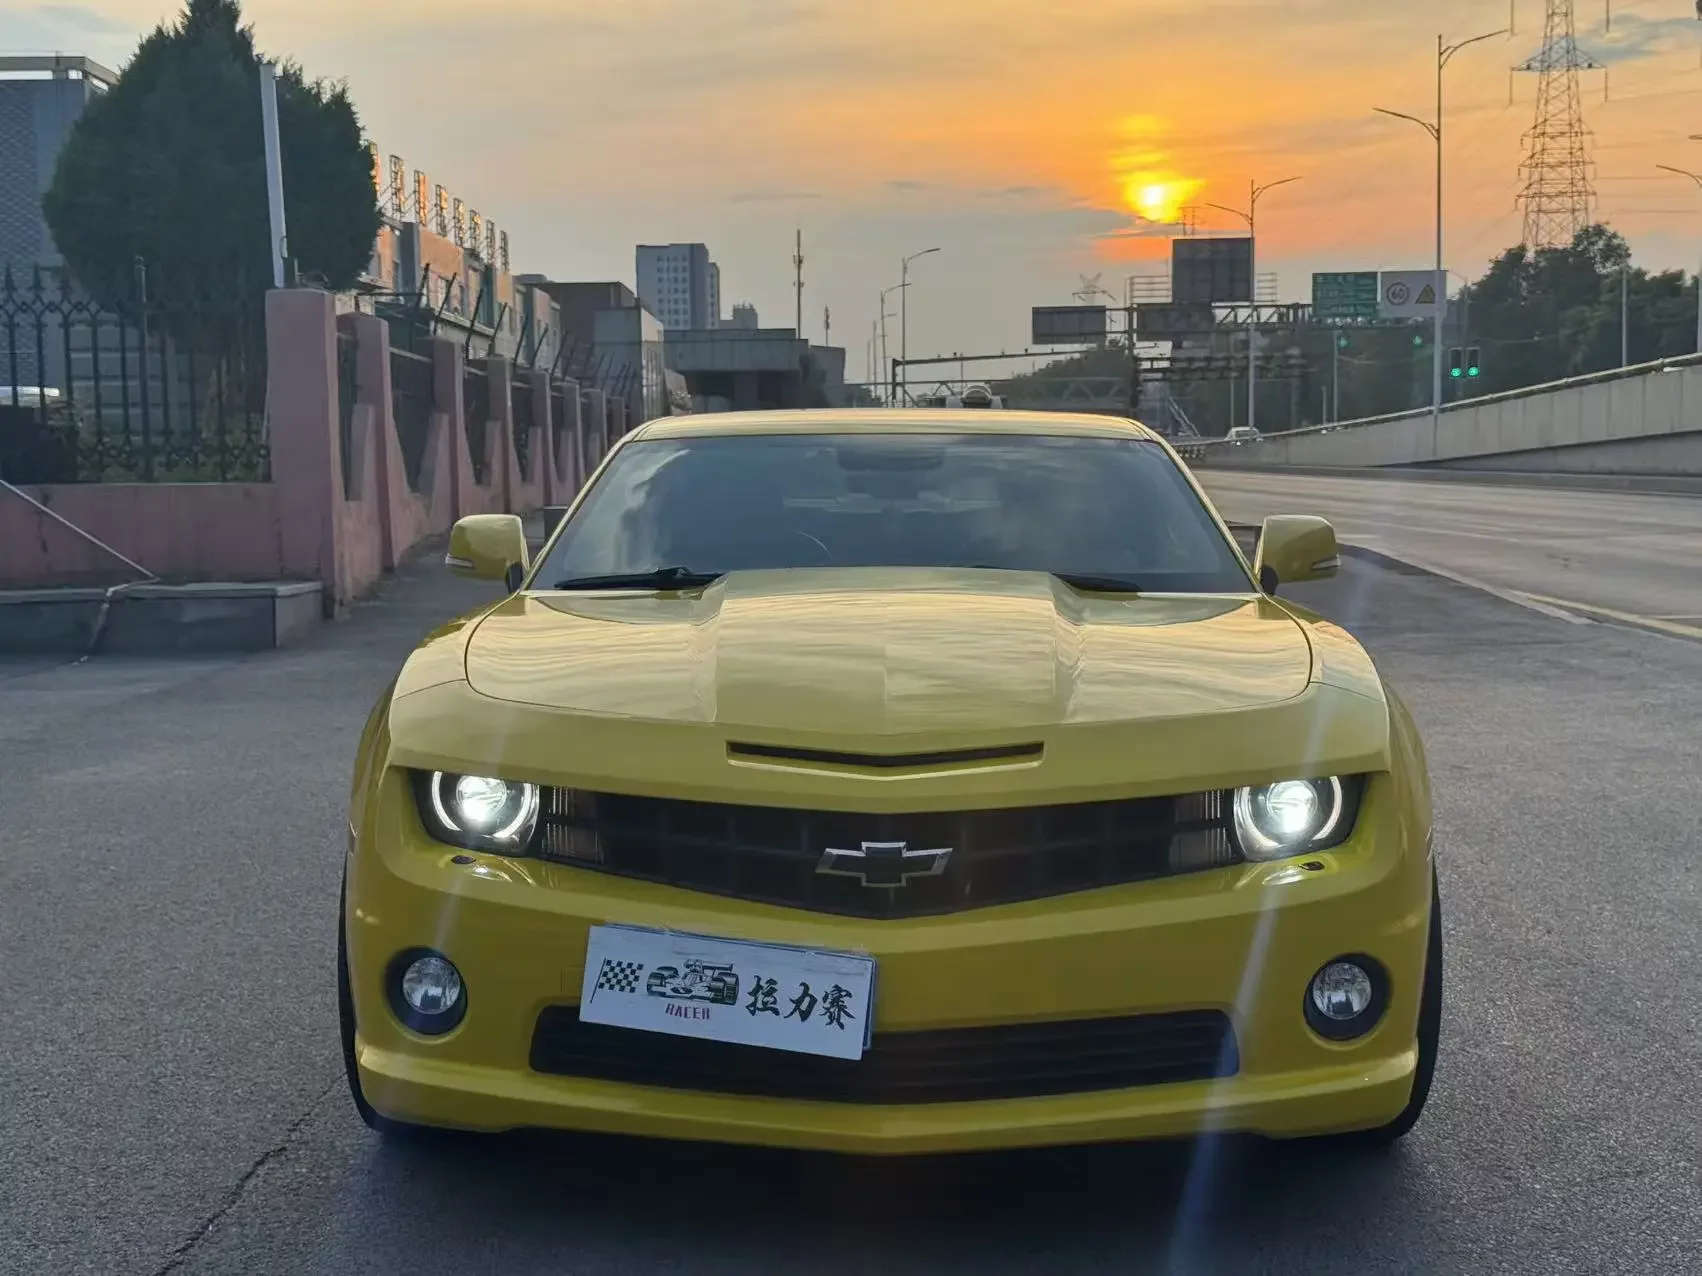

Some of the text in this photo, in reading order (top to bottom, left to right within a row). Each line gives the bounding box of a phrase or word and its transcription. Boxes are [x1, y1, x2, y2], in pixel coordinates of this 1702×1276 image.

[665, 1003, 710, 1020] RACER
[745, 974, 856, 1030] 拉力赛
